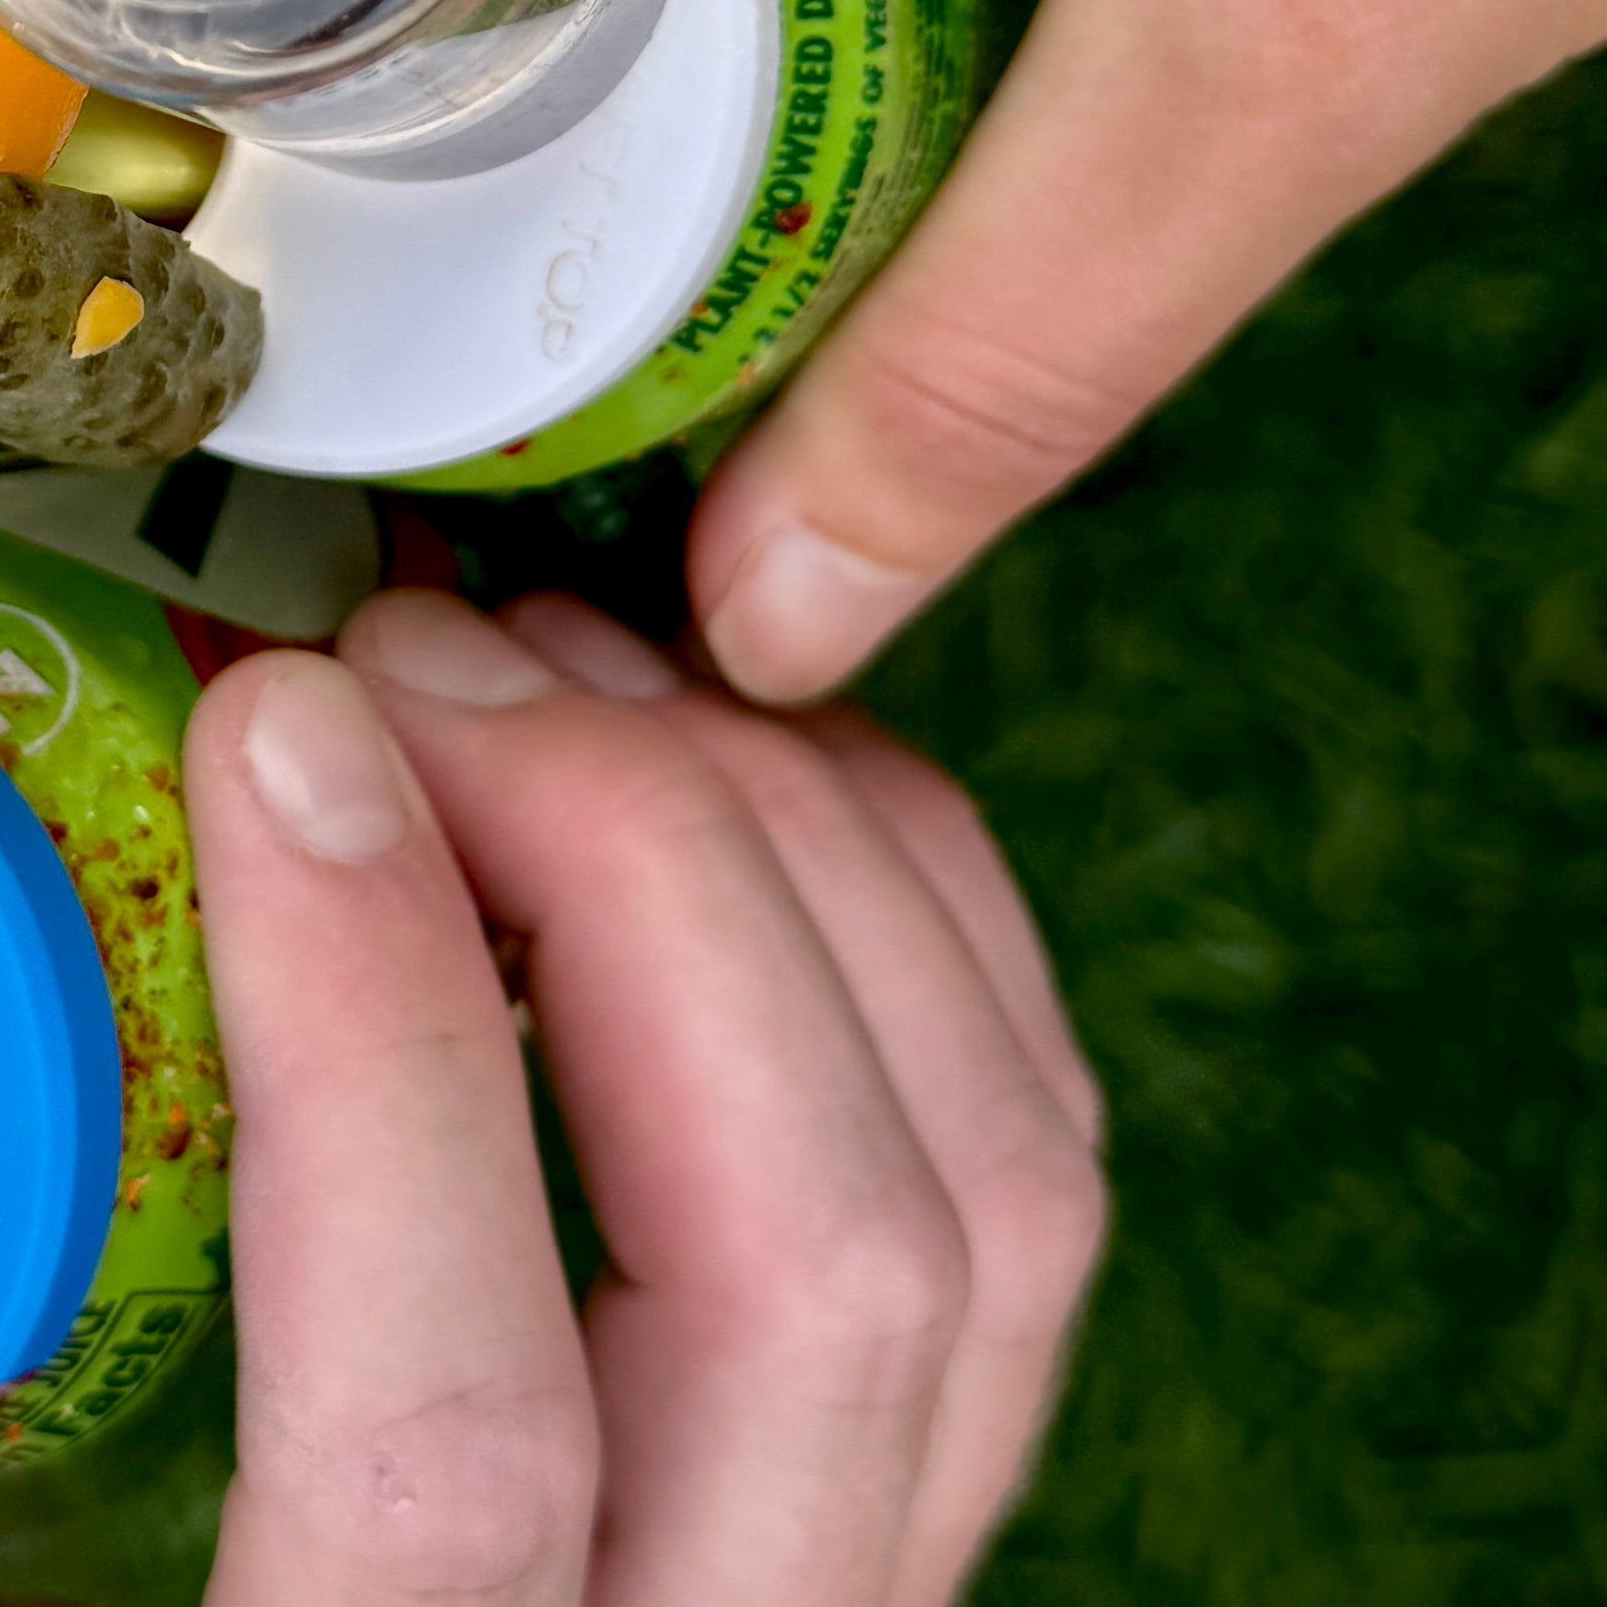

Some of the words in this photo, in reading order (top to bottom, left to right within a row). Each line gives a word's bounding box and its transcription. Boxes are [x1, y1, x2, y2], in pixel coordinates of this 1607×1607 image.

[861, 63, 885, 105] OF
[670, 35, 832, 353] PLANT-POWERED
[28, 1303, 187, 1437] Facts
